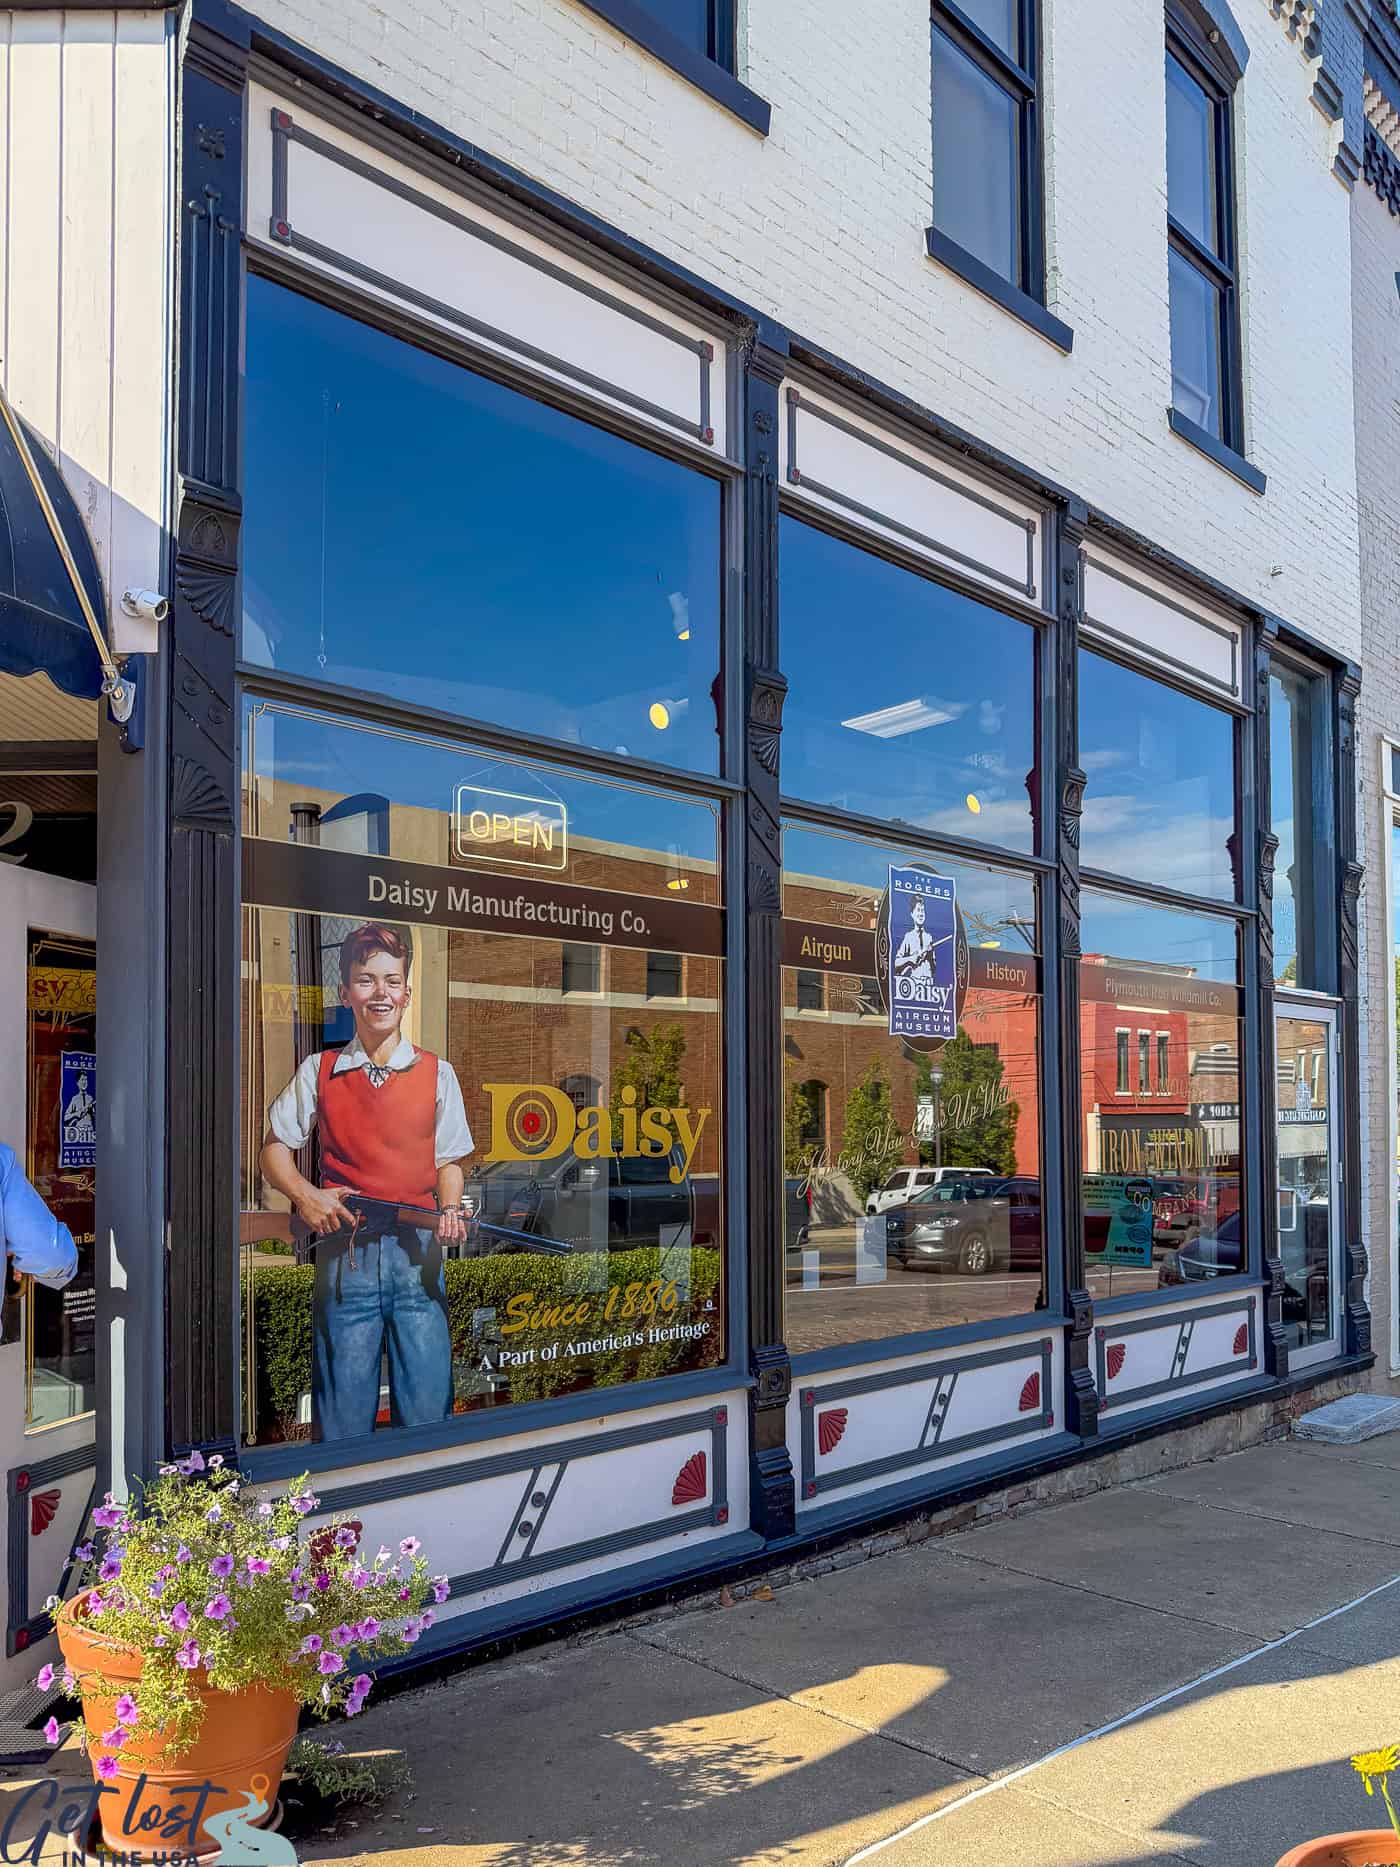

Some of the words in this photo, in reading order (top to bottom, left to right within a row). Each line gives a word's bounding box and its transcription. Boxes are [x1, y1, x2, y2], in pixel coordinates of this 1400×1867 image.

[469, 811, 553, 851] OPEN
[895, 879, 951, 897] ROGERS
[368, 875, 438, 913] Daisy
[447, 886, 614, 935] Manufacturing
[620, 910, 651, 935] Co.
[800, 935, 852, 964] Airgun
[986, 962, 1027, 987] History
[894, 975, 952, 1012] Daisy
[895, 1011, 950, 1023] AIRGUN
[895, 1022, 951, 1033] MUSEUM
[65, 1059, 96, 1068] ROGE
[63, 1126, 96, 1143] Dais
[482, 1083, 711, 1184] Daisy
[1101, 1128, 1141, 1173] IRON
[1151, 1127, 1230, 1170] WINDMILL
[501, 1293, 592, 1334] Since
[603, 1280, 679, 1321] 1886
[480, 1354, 493, 1371] A
[499, 1350, 537, 1367] Part
[540, 1343, 560, 1361] of
[563, 1333, 644, 1358] America's
[648, 1320, 711, 1343] Heritage
